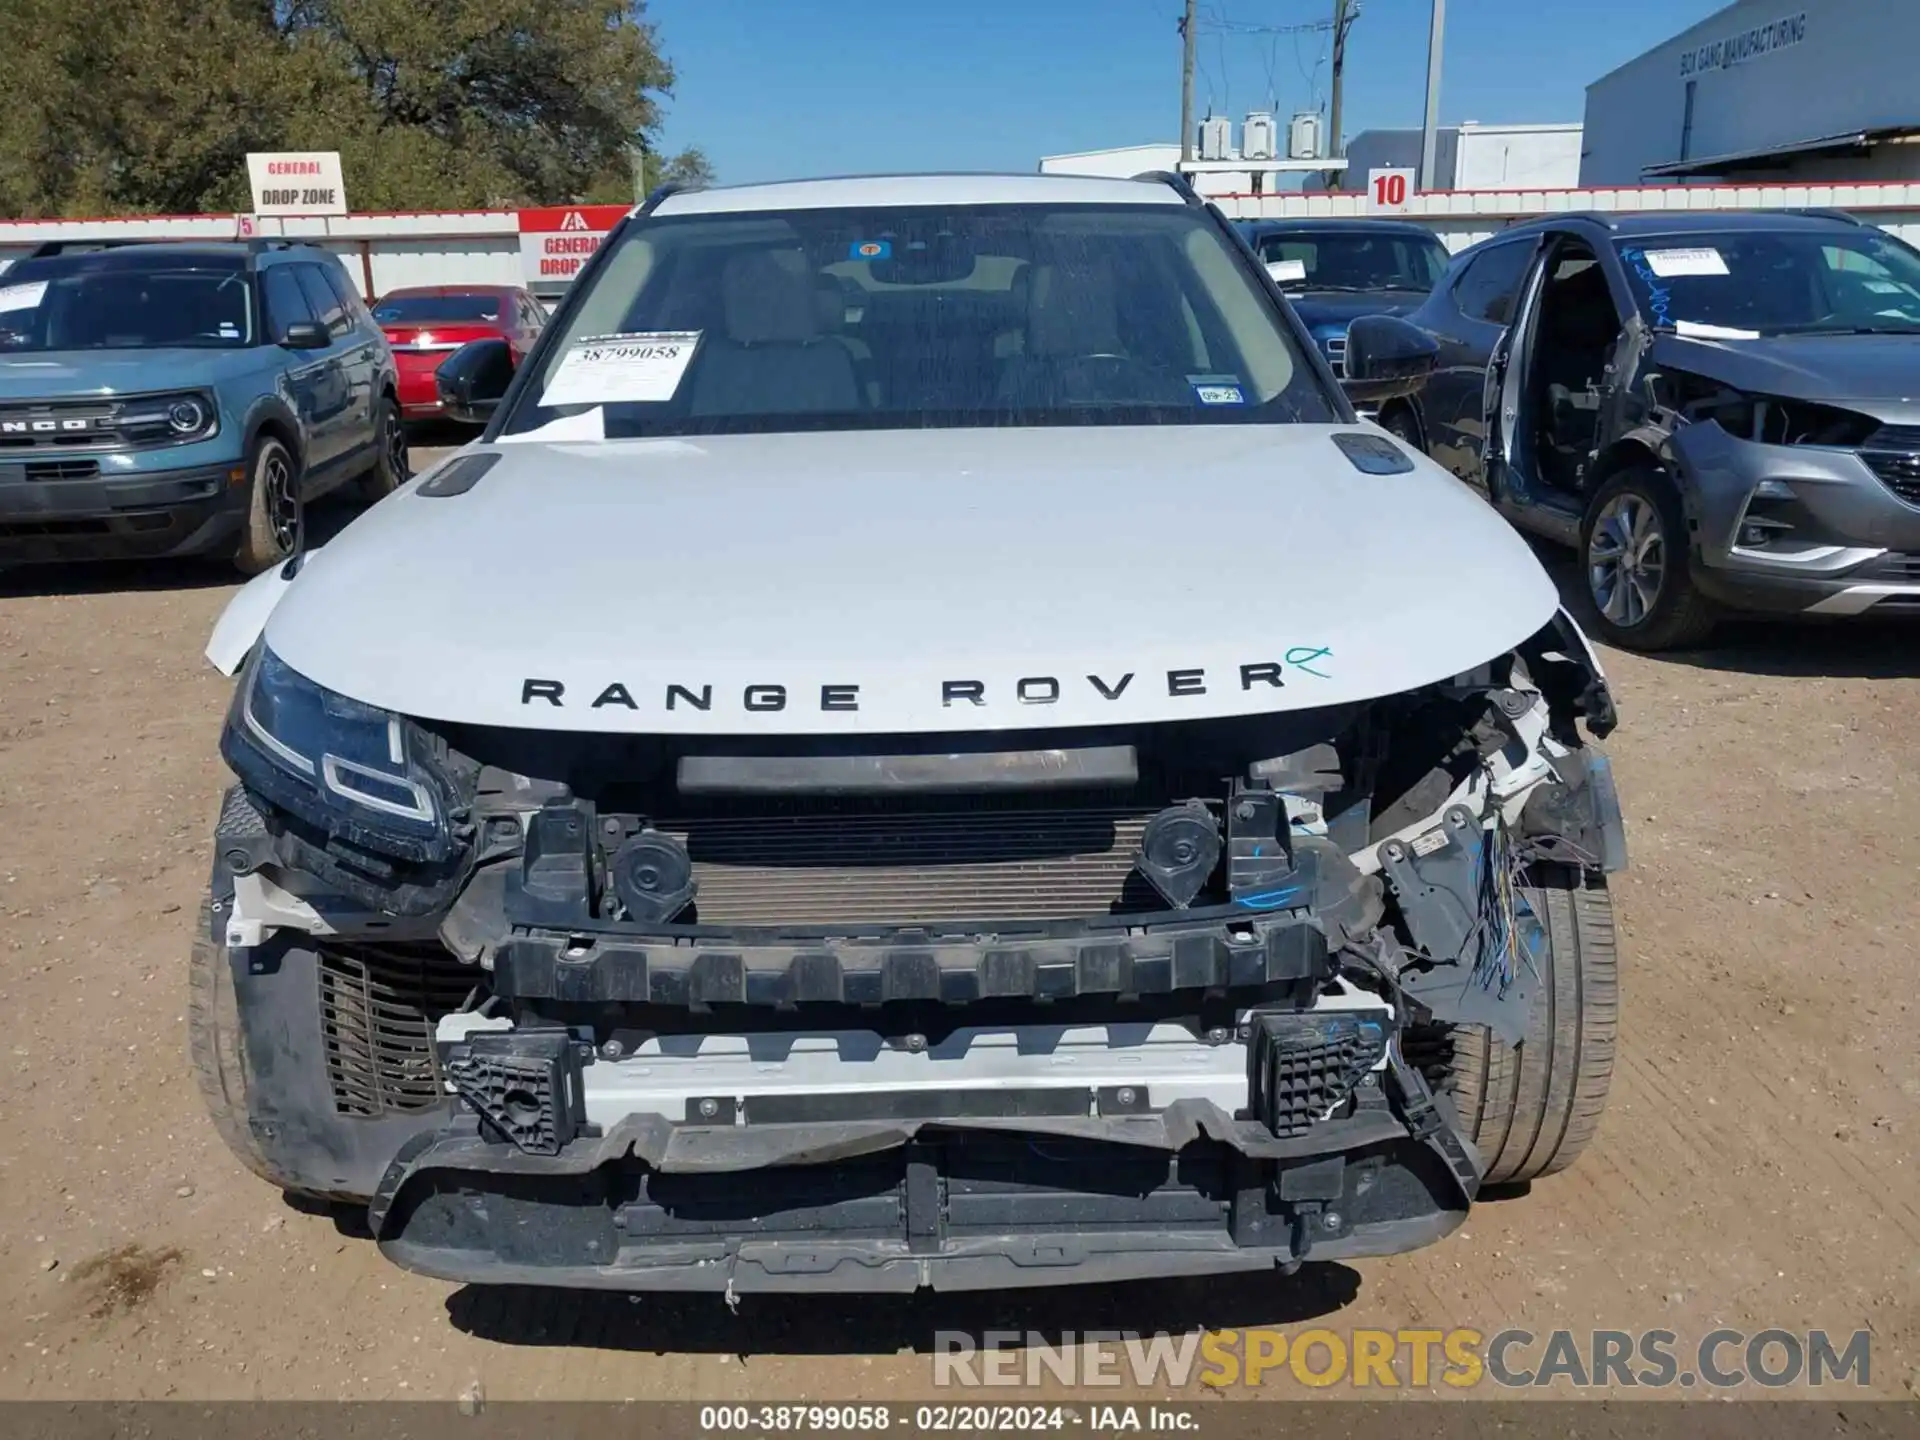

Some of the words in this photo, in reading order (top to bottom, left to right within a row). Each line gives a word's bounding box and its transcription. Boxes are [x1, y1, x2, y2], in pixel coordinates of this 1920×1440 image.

[1721, 13, 1806, 69] MANUFACTURING
[268, 162, 321, 175] GENERAL
[262, 189, 299, 205] DROP
[302, 188, 335, 205] ZONE
[1373, 175, 1406, 205] 10
[241, 217, 252, 235] 5
[540, 258, 580, 276] DROP
[583, 345, 679, 362] 38799058
[521, 678, 860, 712] RANGE
[942, 662, 1285, 707] ROVER
